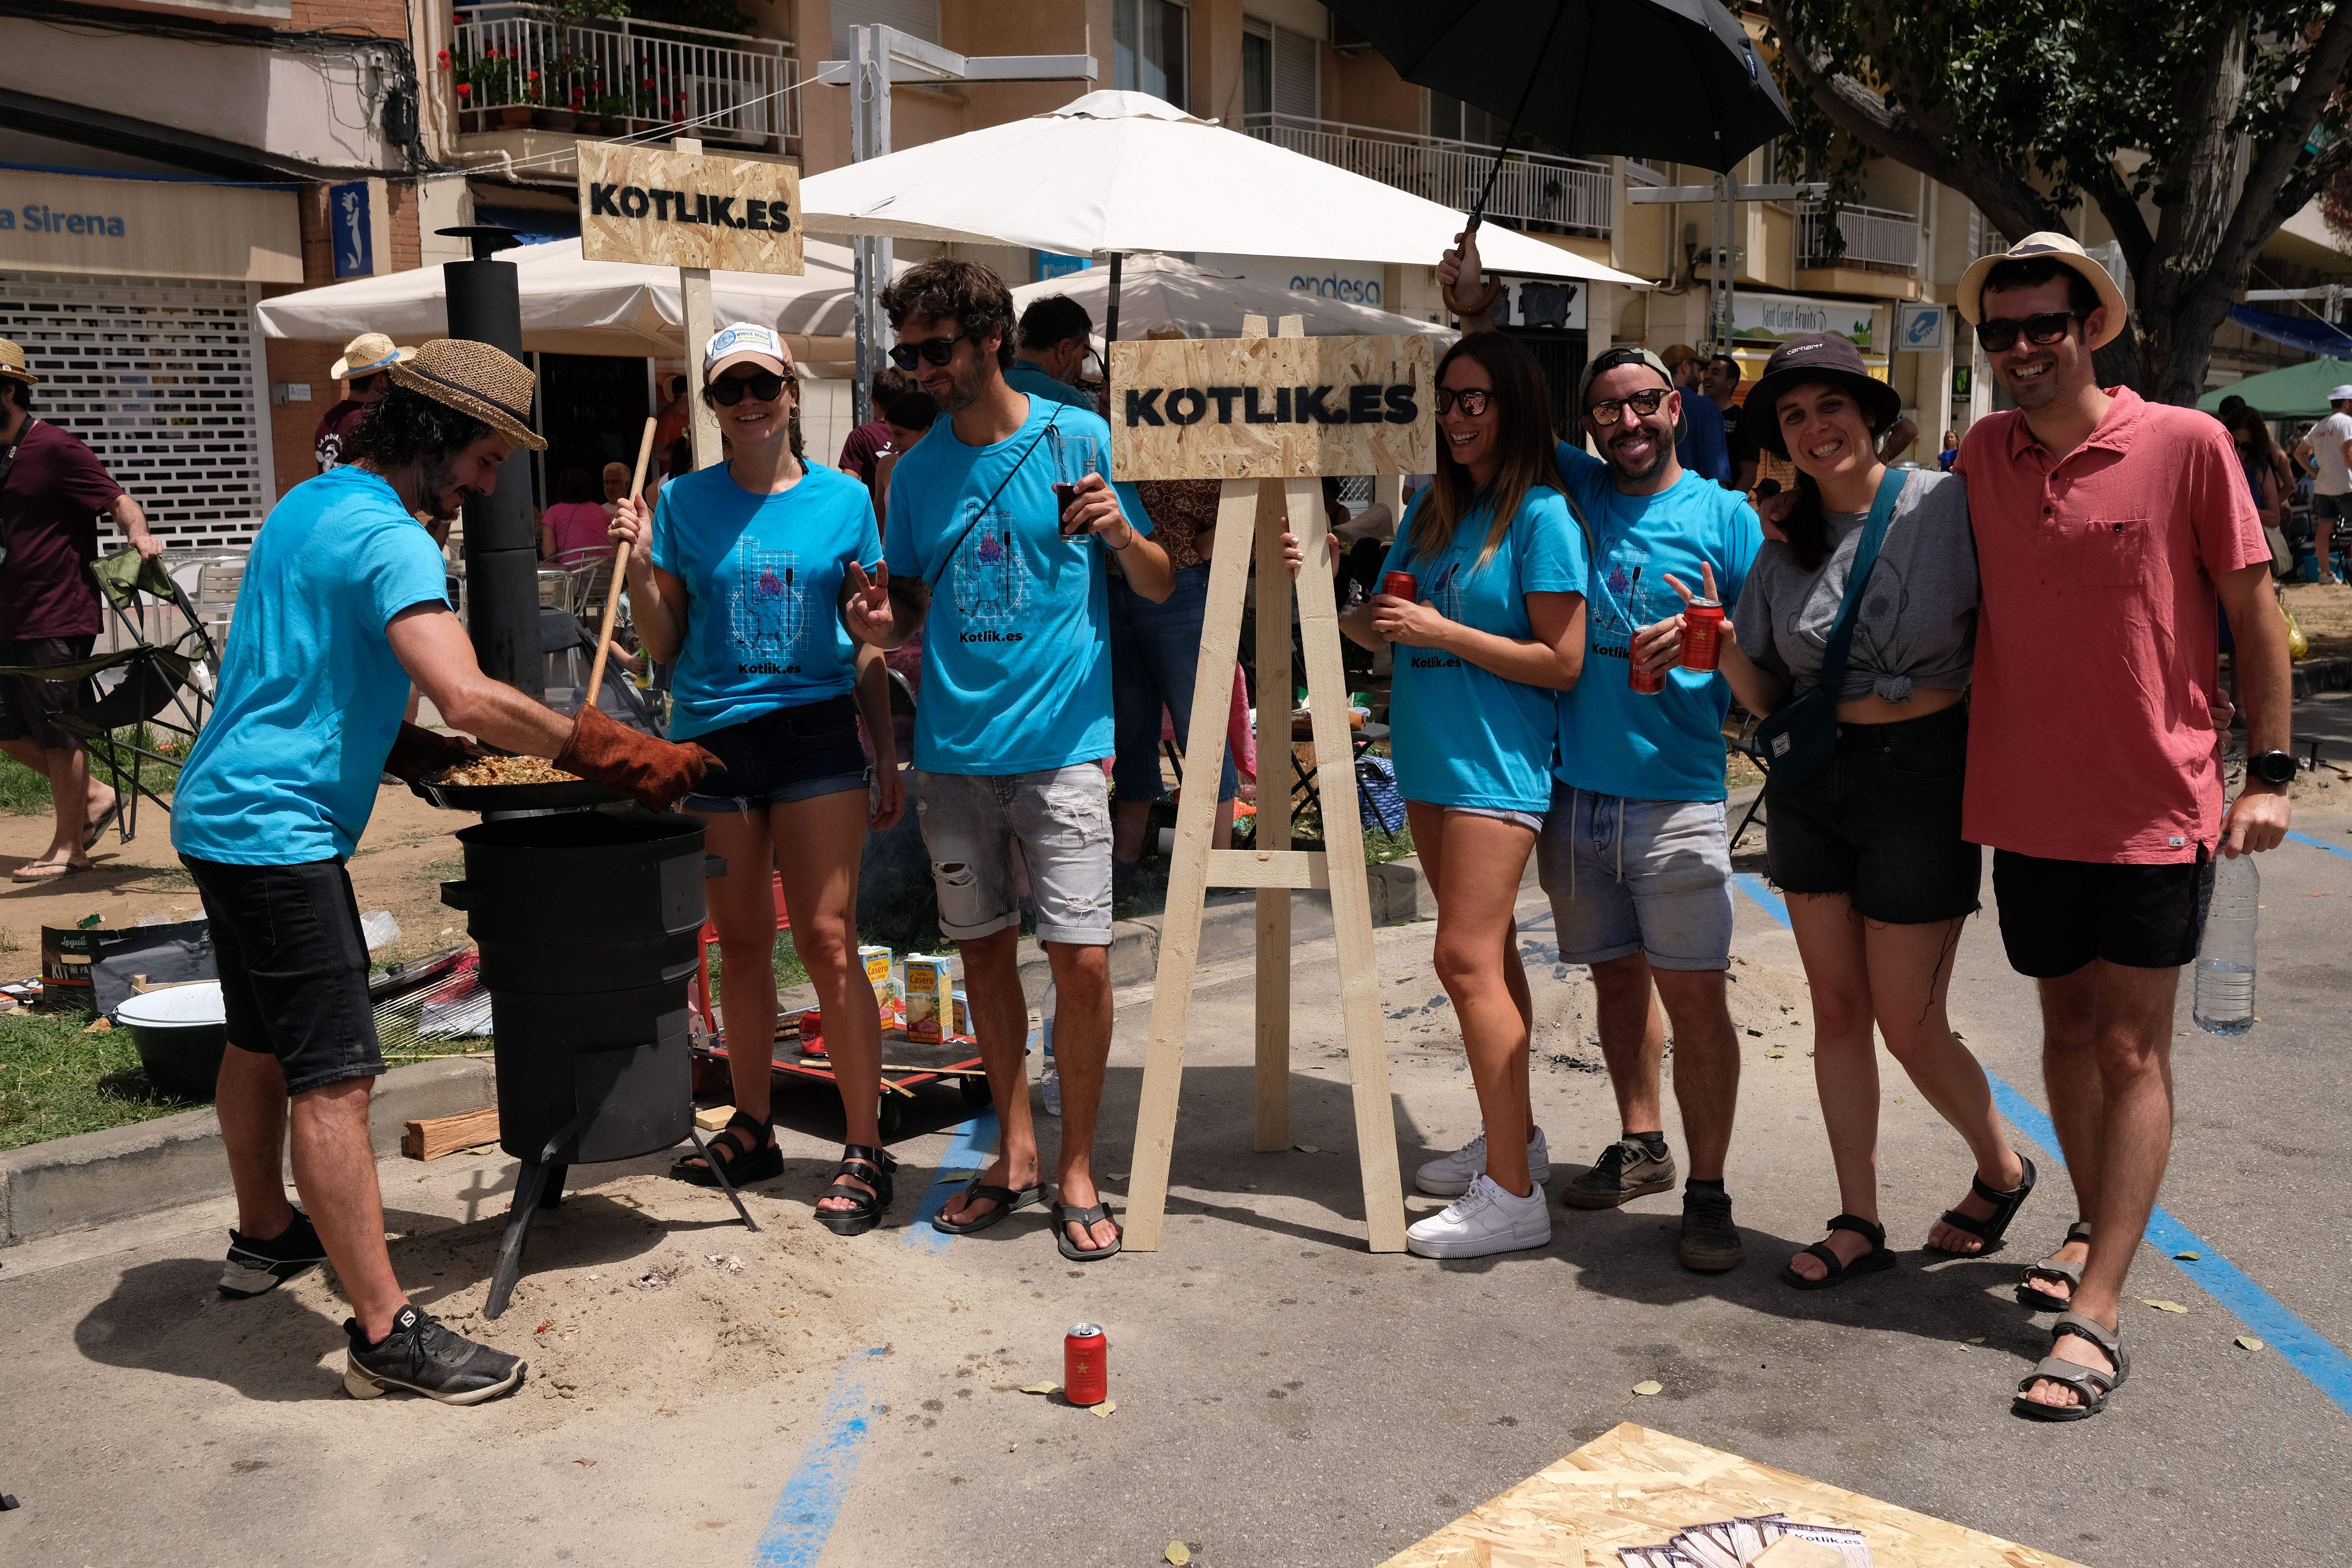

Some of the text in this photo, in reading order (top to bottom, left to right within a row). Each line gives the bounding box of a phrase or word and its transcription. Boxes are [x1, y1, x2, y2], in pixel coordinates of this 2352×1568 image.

[591, 183, 791, 233] KOTLIK.ES
[23, 205, 125, 237] Sirena
[1049, 263, 1078, 274] Punt de
[1290, 270, 1381, 304] endesa
[1762, 302, 1816, 332] Sant Cugat Fruits
[755, 332, 769, 340] BEACH
[1787, 343, 1823, 355] carhartt
[1126, 385, 1418, 427] KOTLIK.ES
[9, 446, 17, 458] EOS
[960, 630, 1023, 643] Kotlik.es
[1592, 642, 1630, 660] Kotlik
[739, 662, 802, 674] Kotlik.es
[1412, 655, 1462, 668] Kotlik.es
[52, 963, 69, 980] KIT
[867, 965, 888, 976] Casero
[909, 975, 933, 985] Casero
